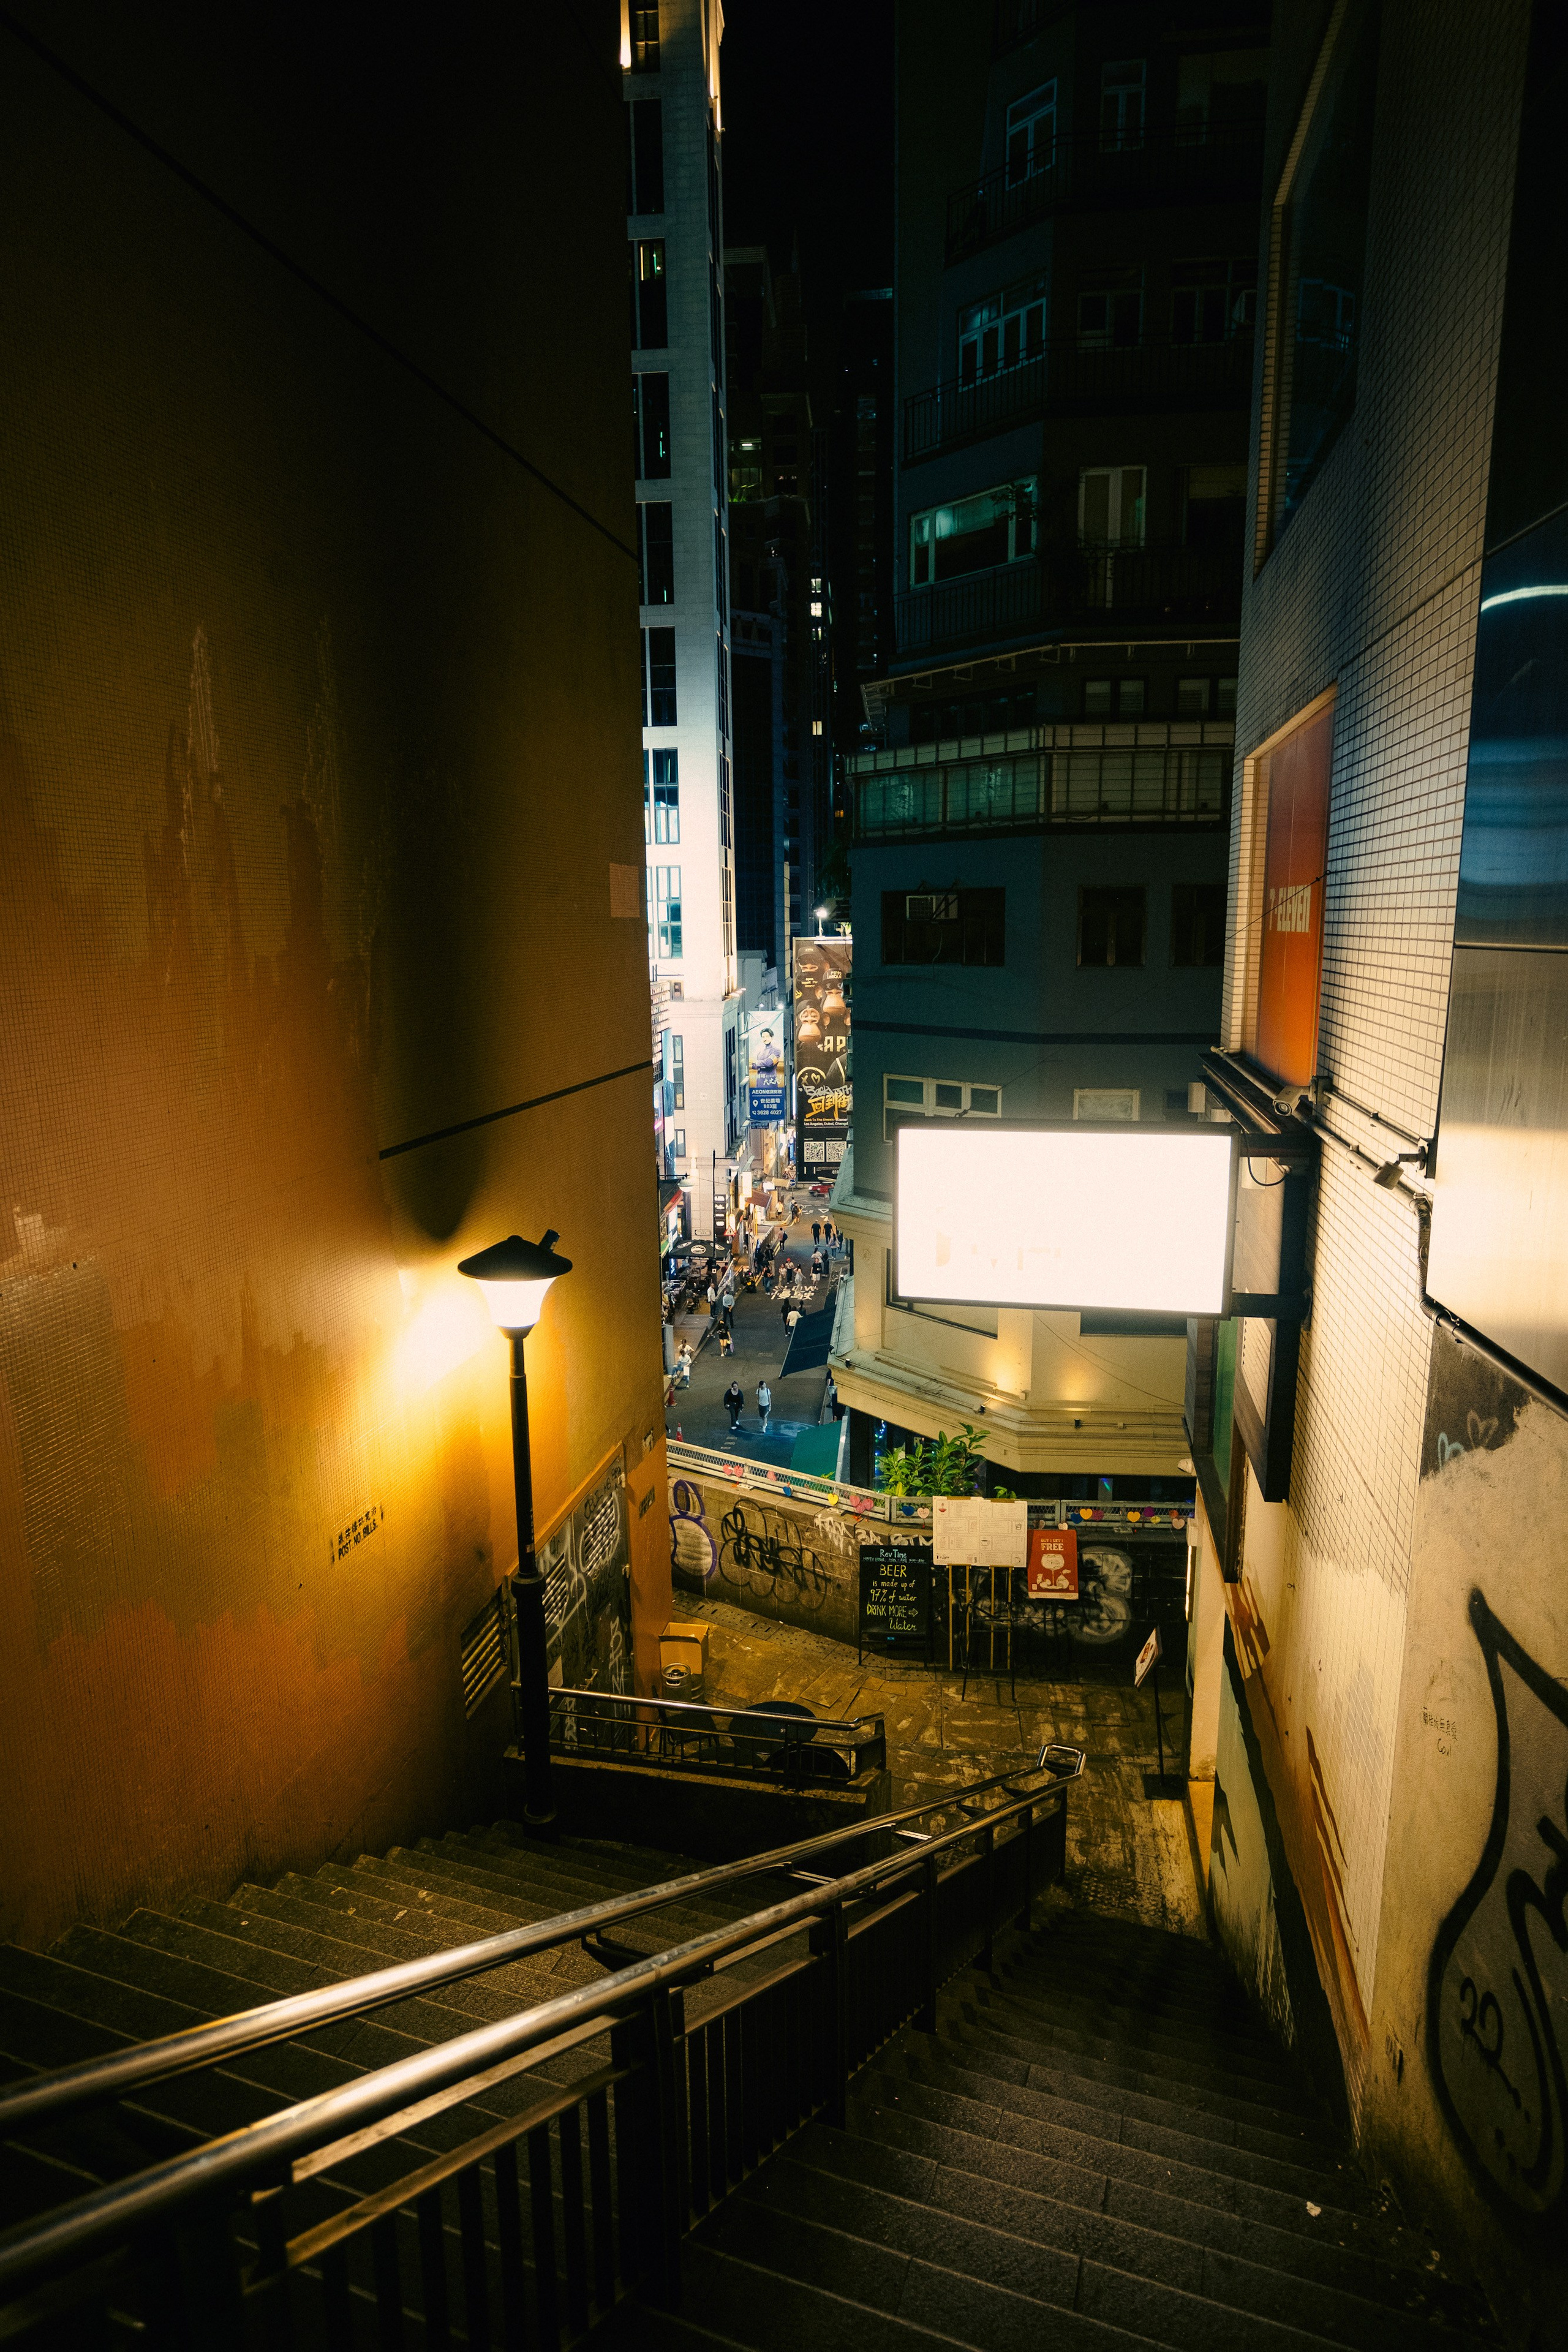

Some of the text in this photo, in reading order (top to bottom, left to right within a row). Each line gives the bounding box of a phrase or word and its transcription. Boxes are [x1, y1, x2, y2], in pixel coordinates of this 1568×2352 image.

[771, 1291, 815, 1300] 慢駛
[880, 1564, 907, 1578] BEER
[881, 1578, 898, 1588] made
[901, 1582, 908, 1591] up
[908, 1580, 916, 1588] of
[870, 1588, 888, 1602] 97%
[889, 1590, 896, 1603] of
[889, 1605, 907, 1618] MORE
[889, 1617, 917, 1631] Water
